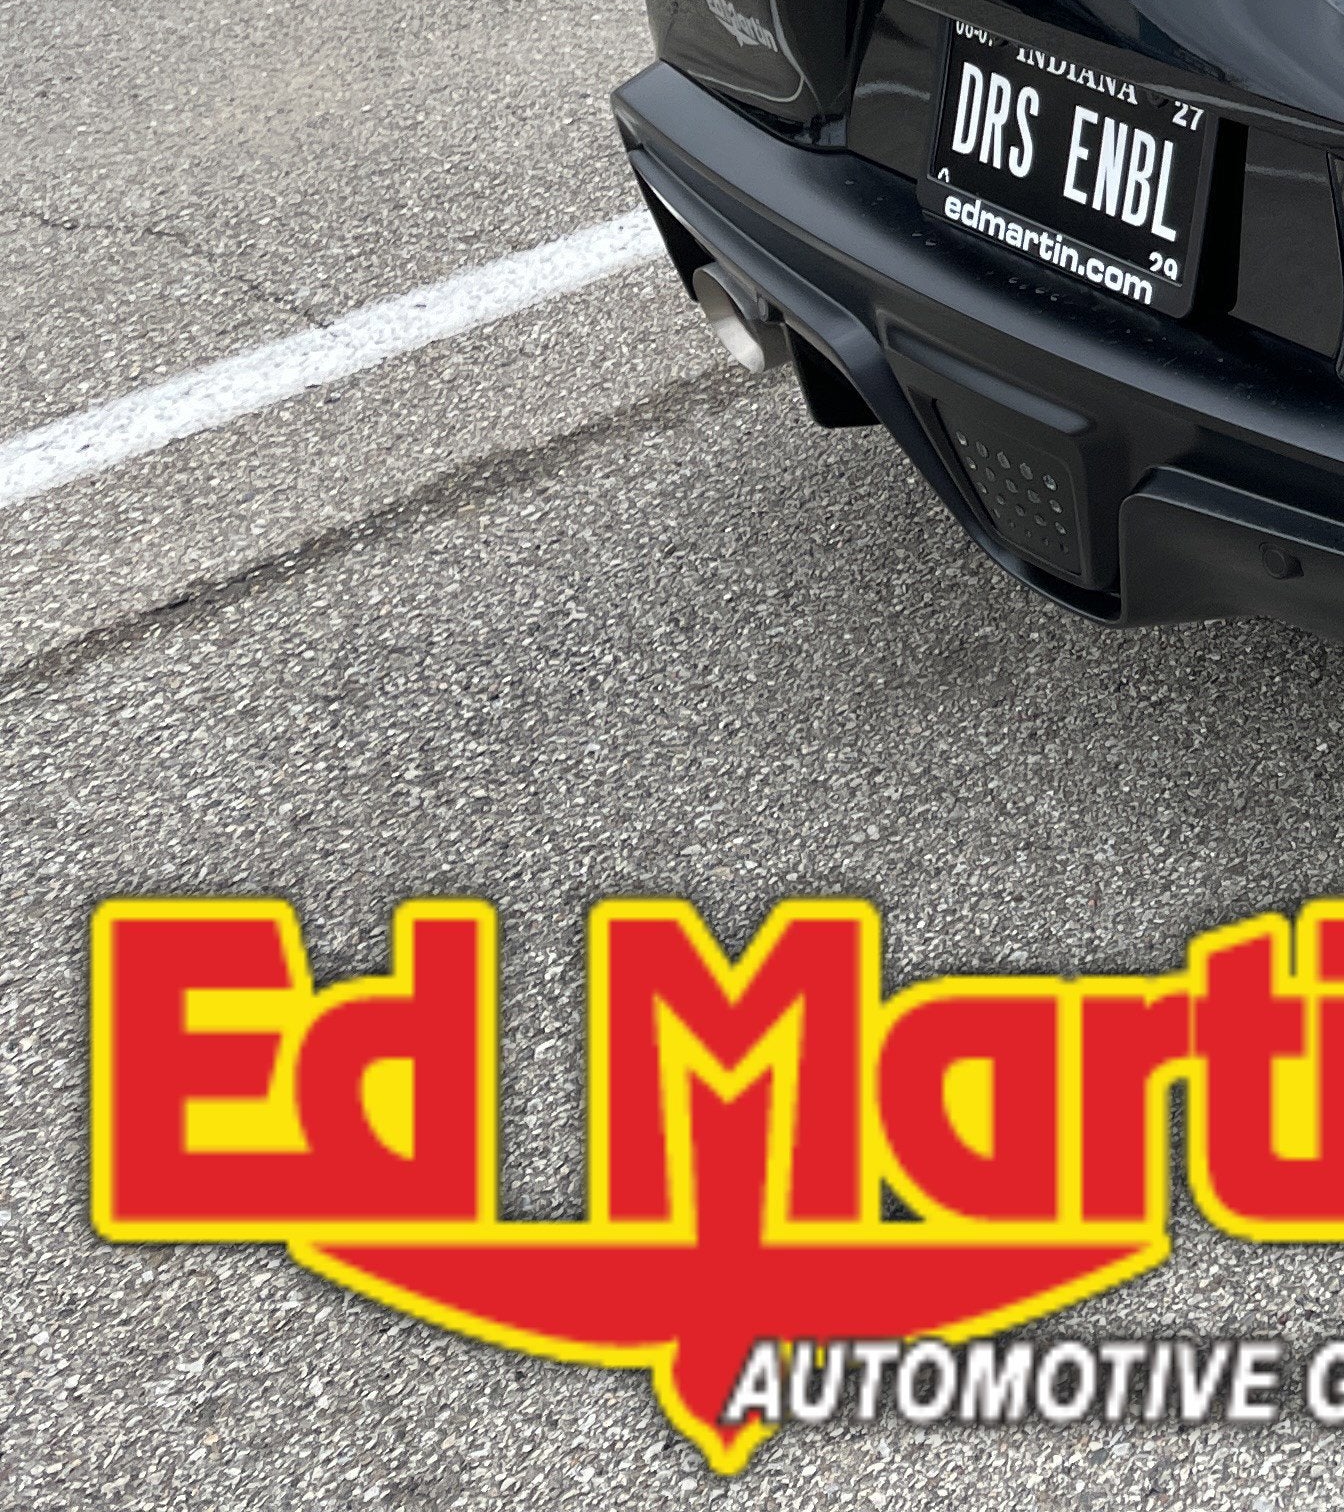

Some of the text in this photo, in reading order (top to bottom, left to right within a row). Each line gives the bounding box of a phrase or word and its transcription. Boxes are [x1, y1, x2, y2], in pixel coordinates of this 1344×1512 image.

[1016, 47, 1205, 131] INDIANA 27
[952, 61, 1178, 242] DRS ENBL
[944, 194, 1154, 305] edmartin.com
